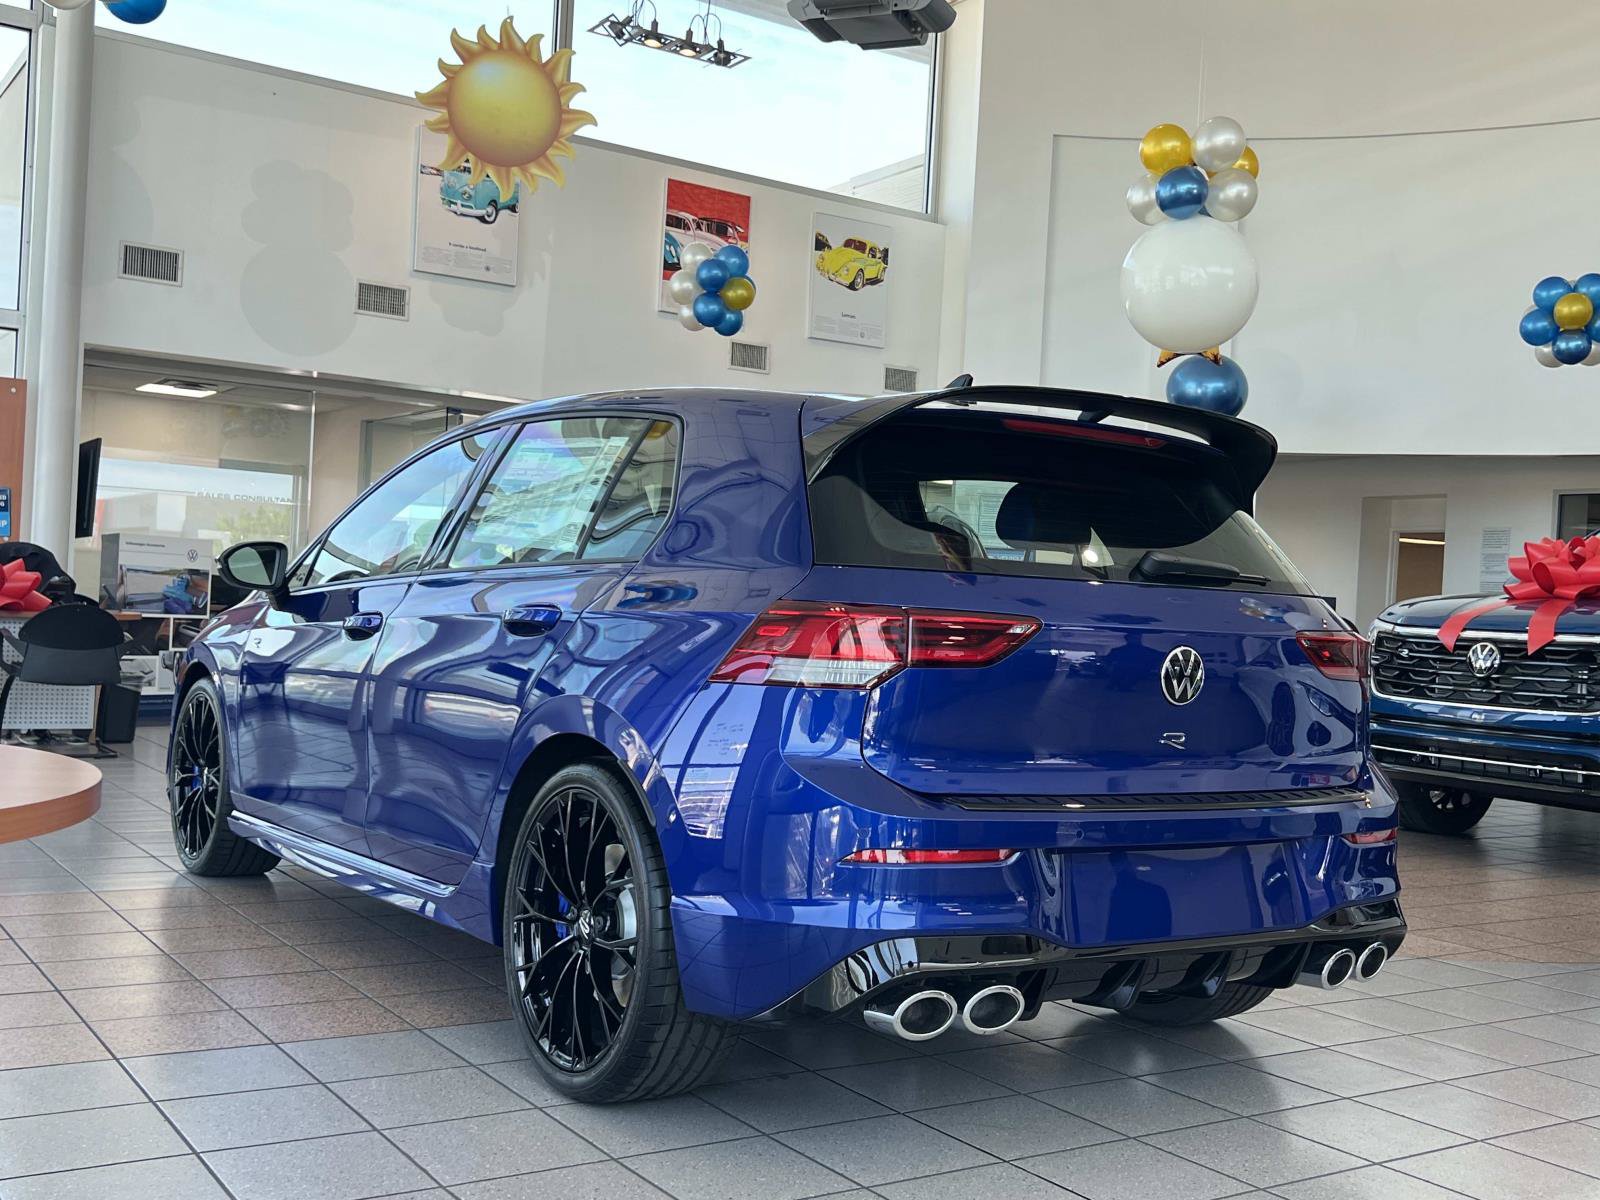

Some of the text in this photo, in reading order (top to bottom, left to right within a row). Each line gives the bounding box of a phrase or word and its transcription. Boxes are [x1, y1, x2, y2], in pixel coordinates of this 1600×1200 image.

[1162, 647, 1205, 704] VW
[1468, 643, 1499, 676] VW
[1158, 732, 1186, 750] R
